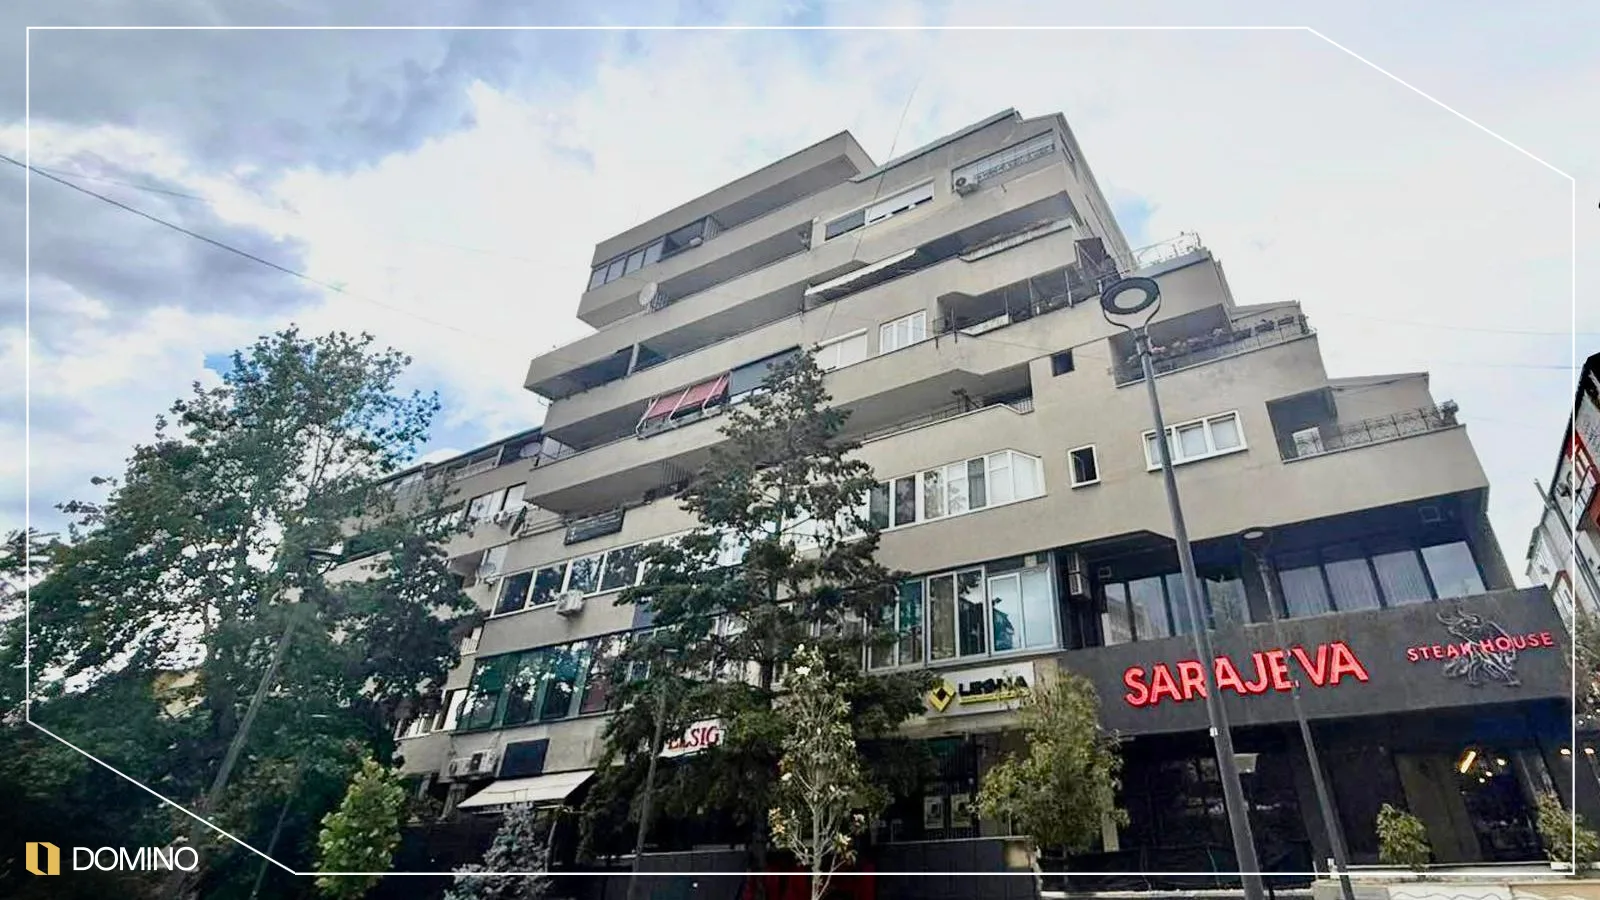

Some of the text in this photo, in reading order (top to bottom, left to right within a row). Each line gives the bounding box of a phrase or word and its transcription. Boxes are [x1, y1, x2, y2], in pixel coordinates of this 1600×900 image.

[1407, 631, 1554, 663] STEAK HOUSE
[1123, 640, 1369, 709] SARAJEVA
